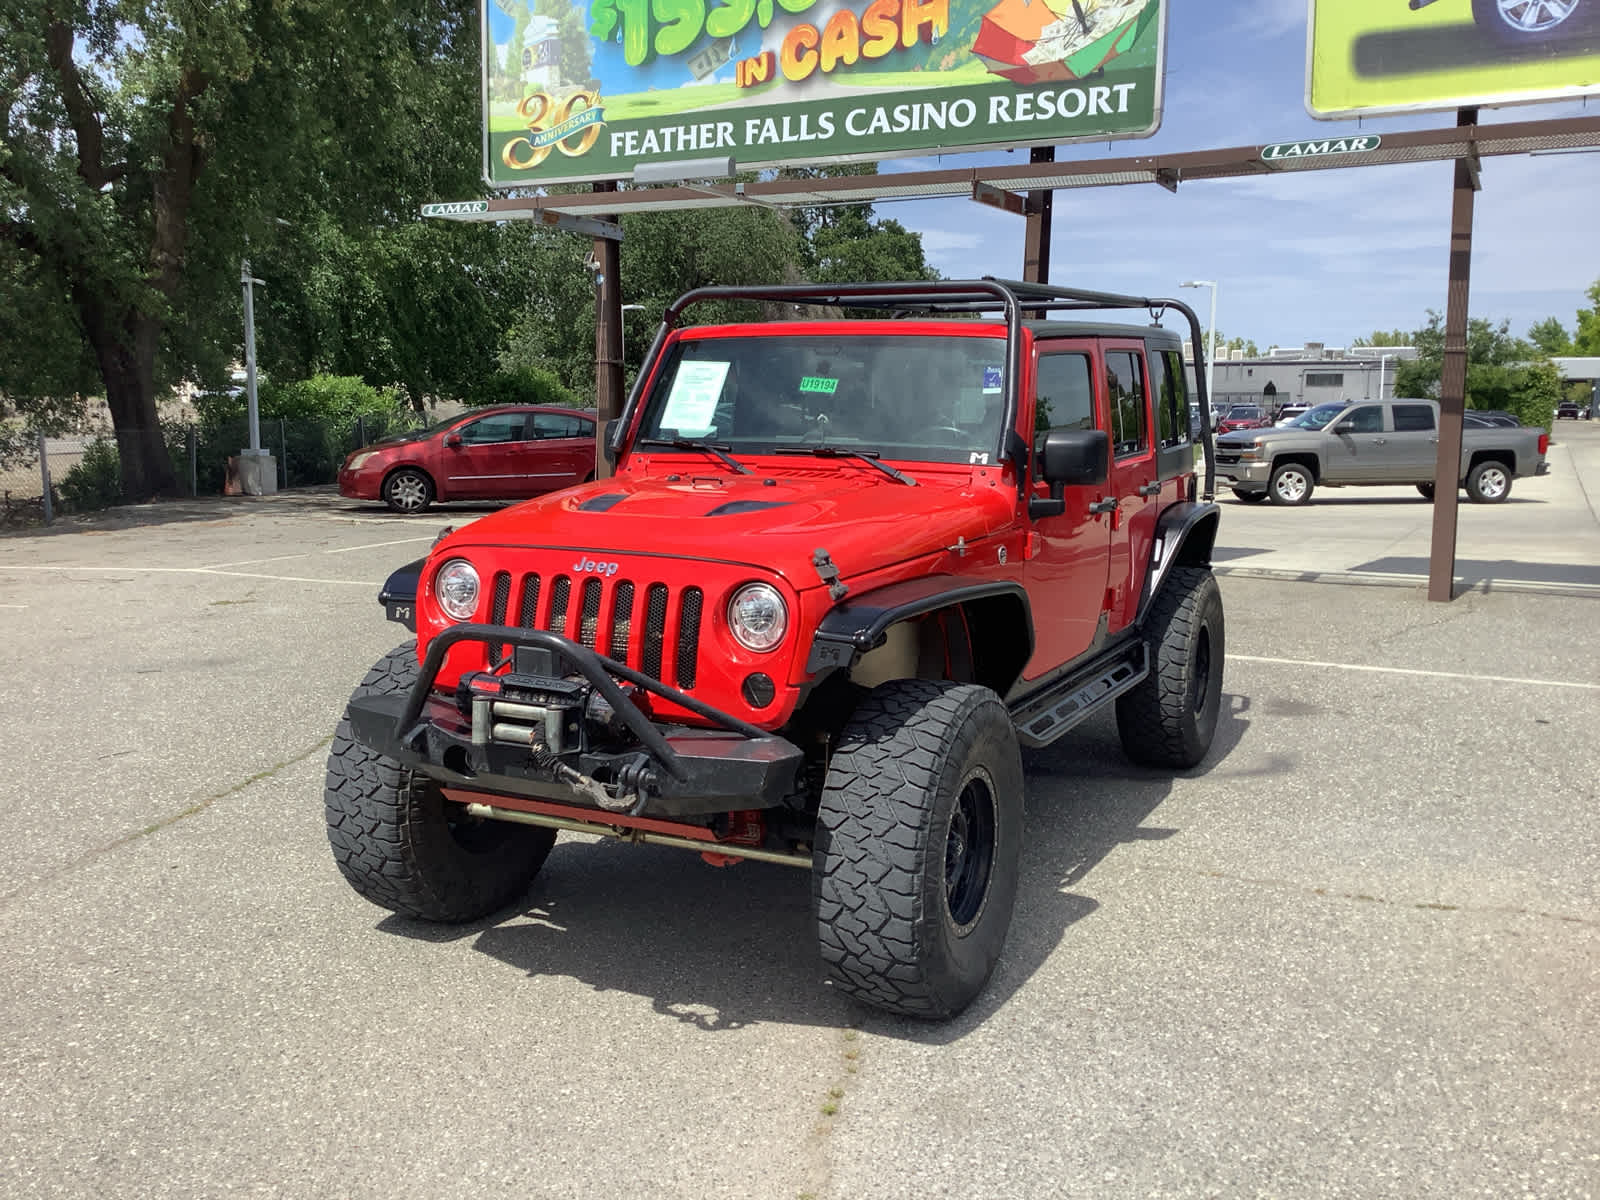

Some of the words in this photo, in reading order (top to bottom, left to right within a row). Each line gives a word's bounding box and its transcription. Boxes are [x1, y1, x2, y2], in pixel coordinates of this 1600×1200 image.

[736, 52, 773, 88] IN
[780, 0, 949, 81] CASH
[534, 111, 598, 147] ANNIVERSARY
[610, 121, 736, 157] FEATHER
[745, 111, 836, 146] FALLS
[845, 99, 977, 136] CASINO
[988, 83, 1137, 125] RESORT
[1271, 138, 1369, 158] LAMAR
[427, 202, 482, 215] LAMAR
[573, 556, 618, 577] Jeep
